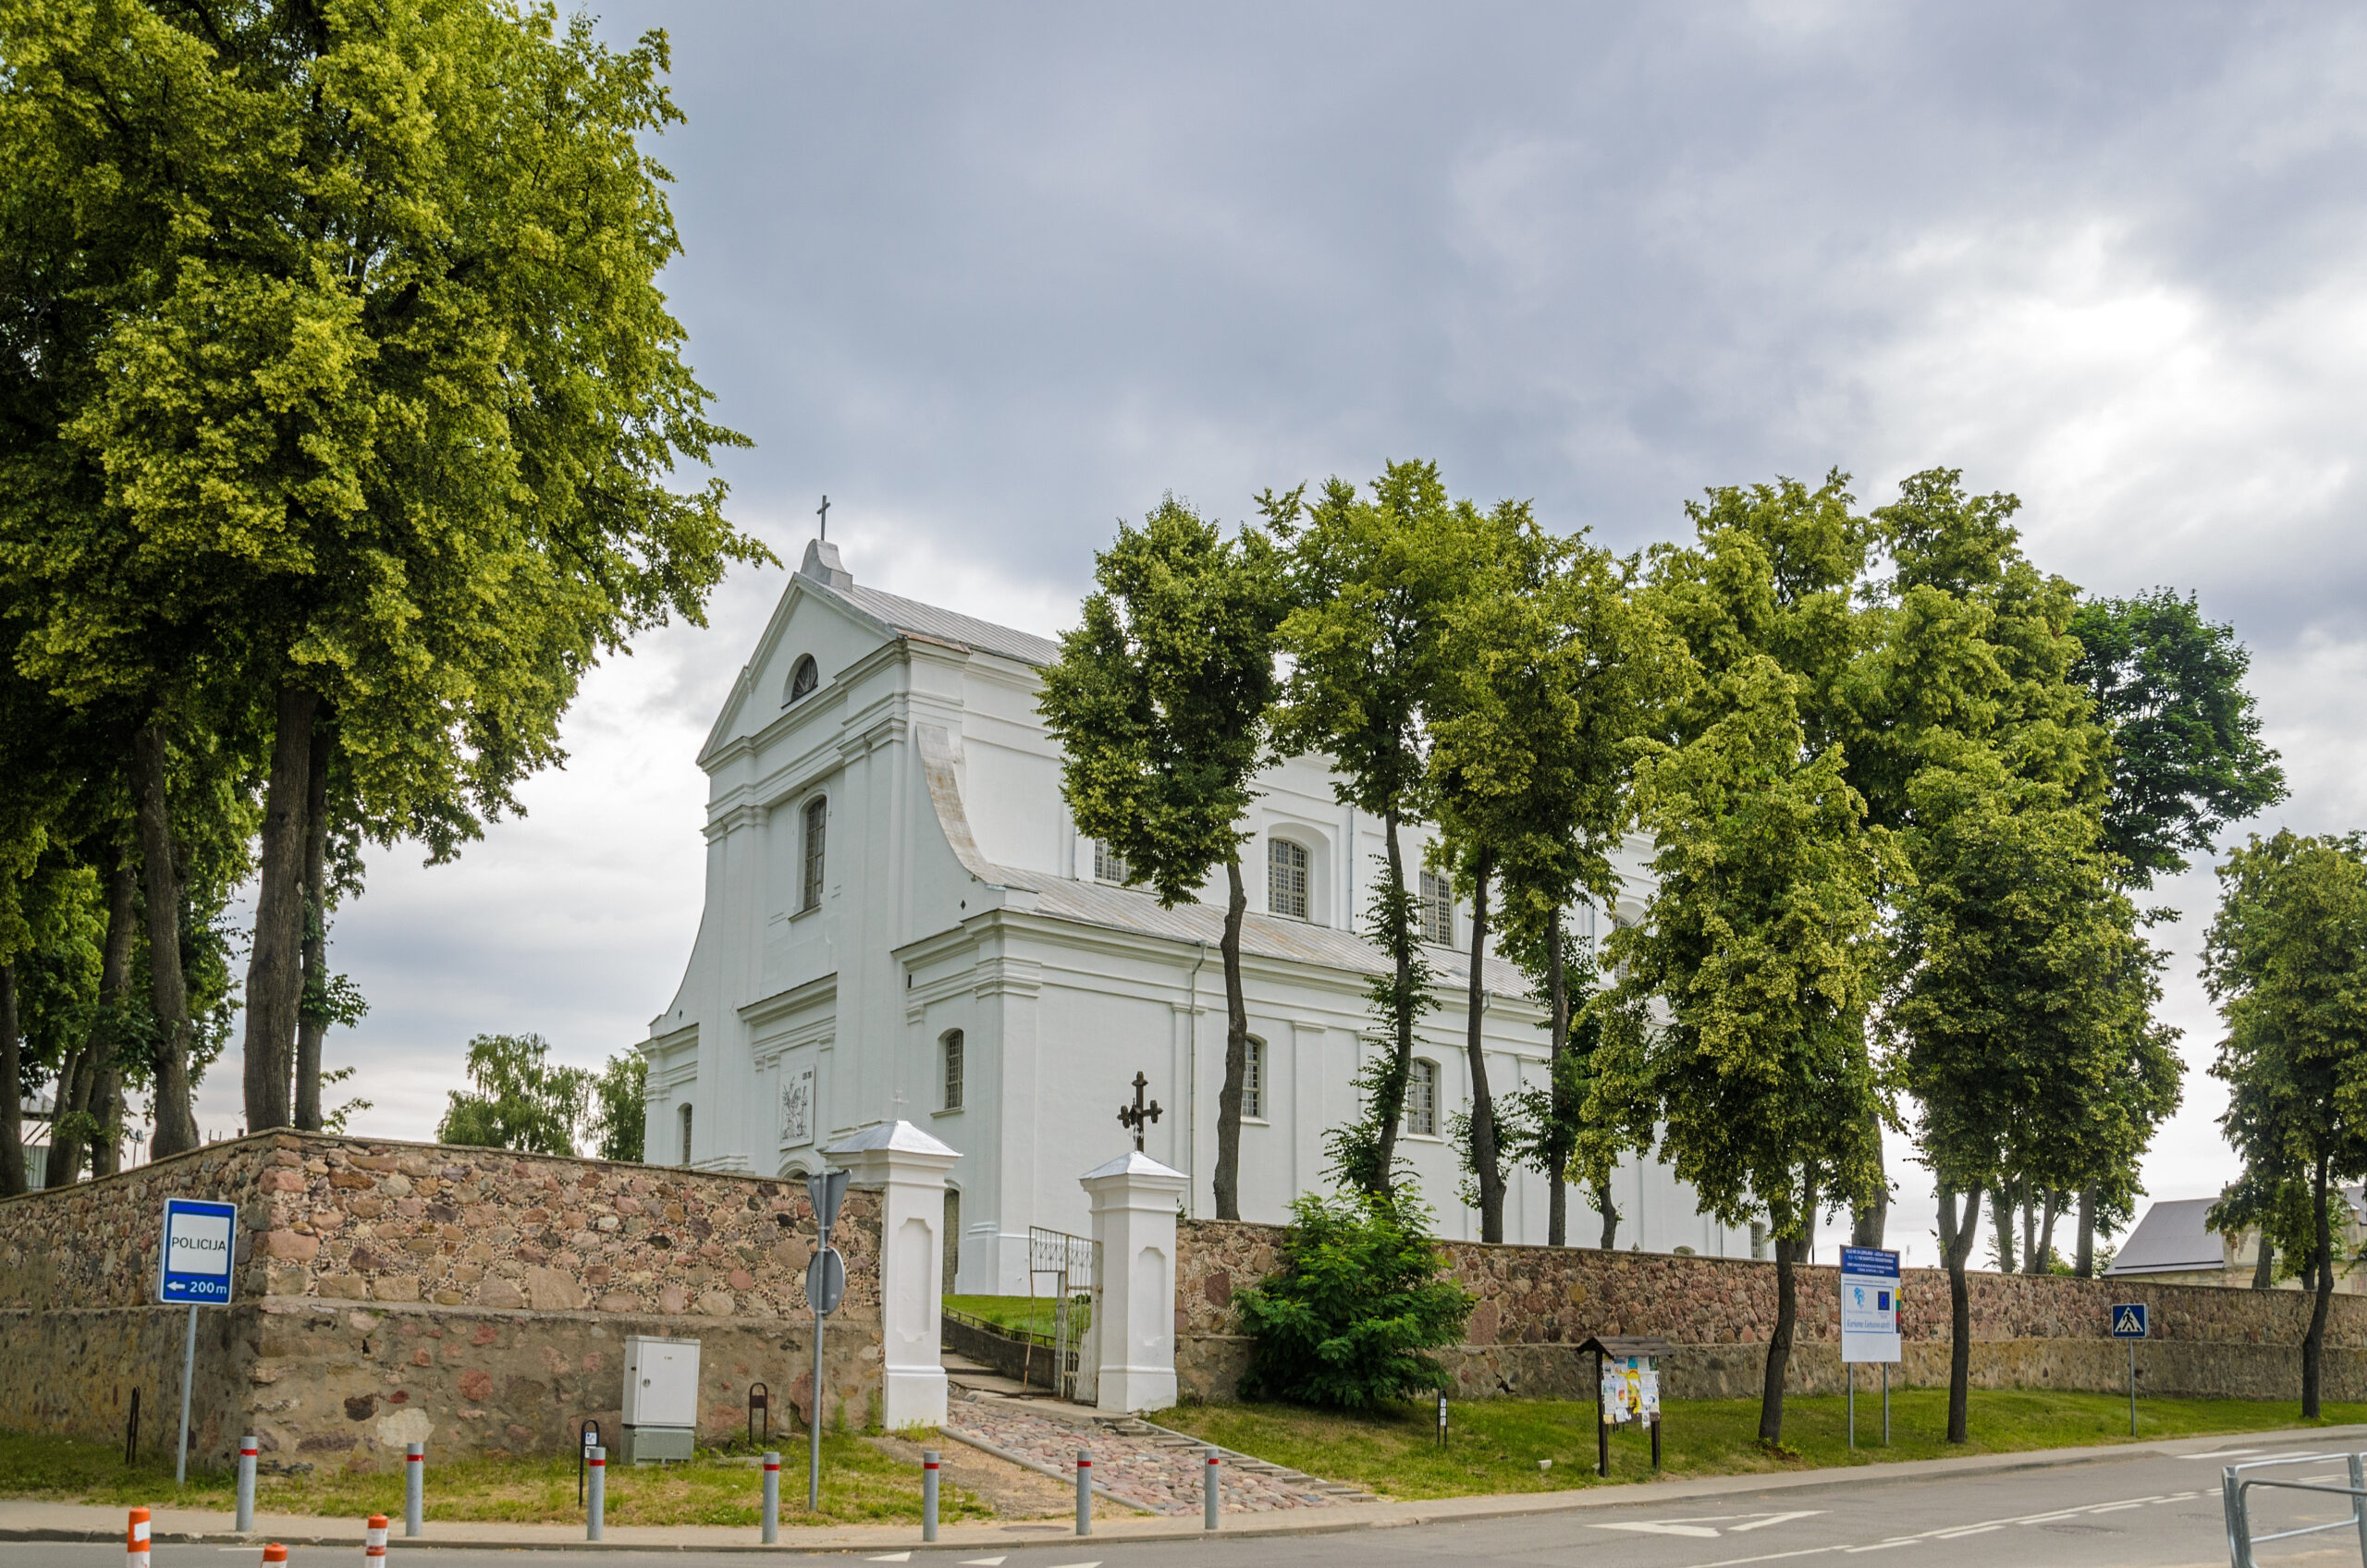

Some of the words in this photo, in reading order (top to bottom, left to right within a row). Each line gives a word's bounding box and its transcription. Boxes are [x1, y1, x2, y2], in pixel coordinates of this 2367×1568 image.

[172, 1237, 226, 1251] POLICIJA
[190, 1281, 215, 1293] 200
[216, 1285, 227, 1293] m
